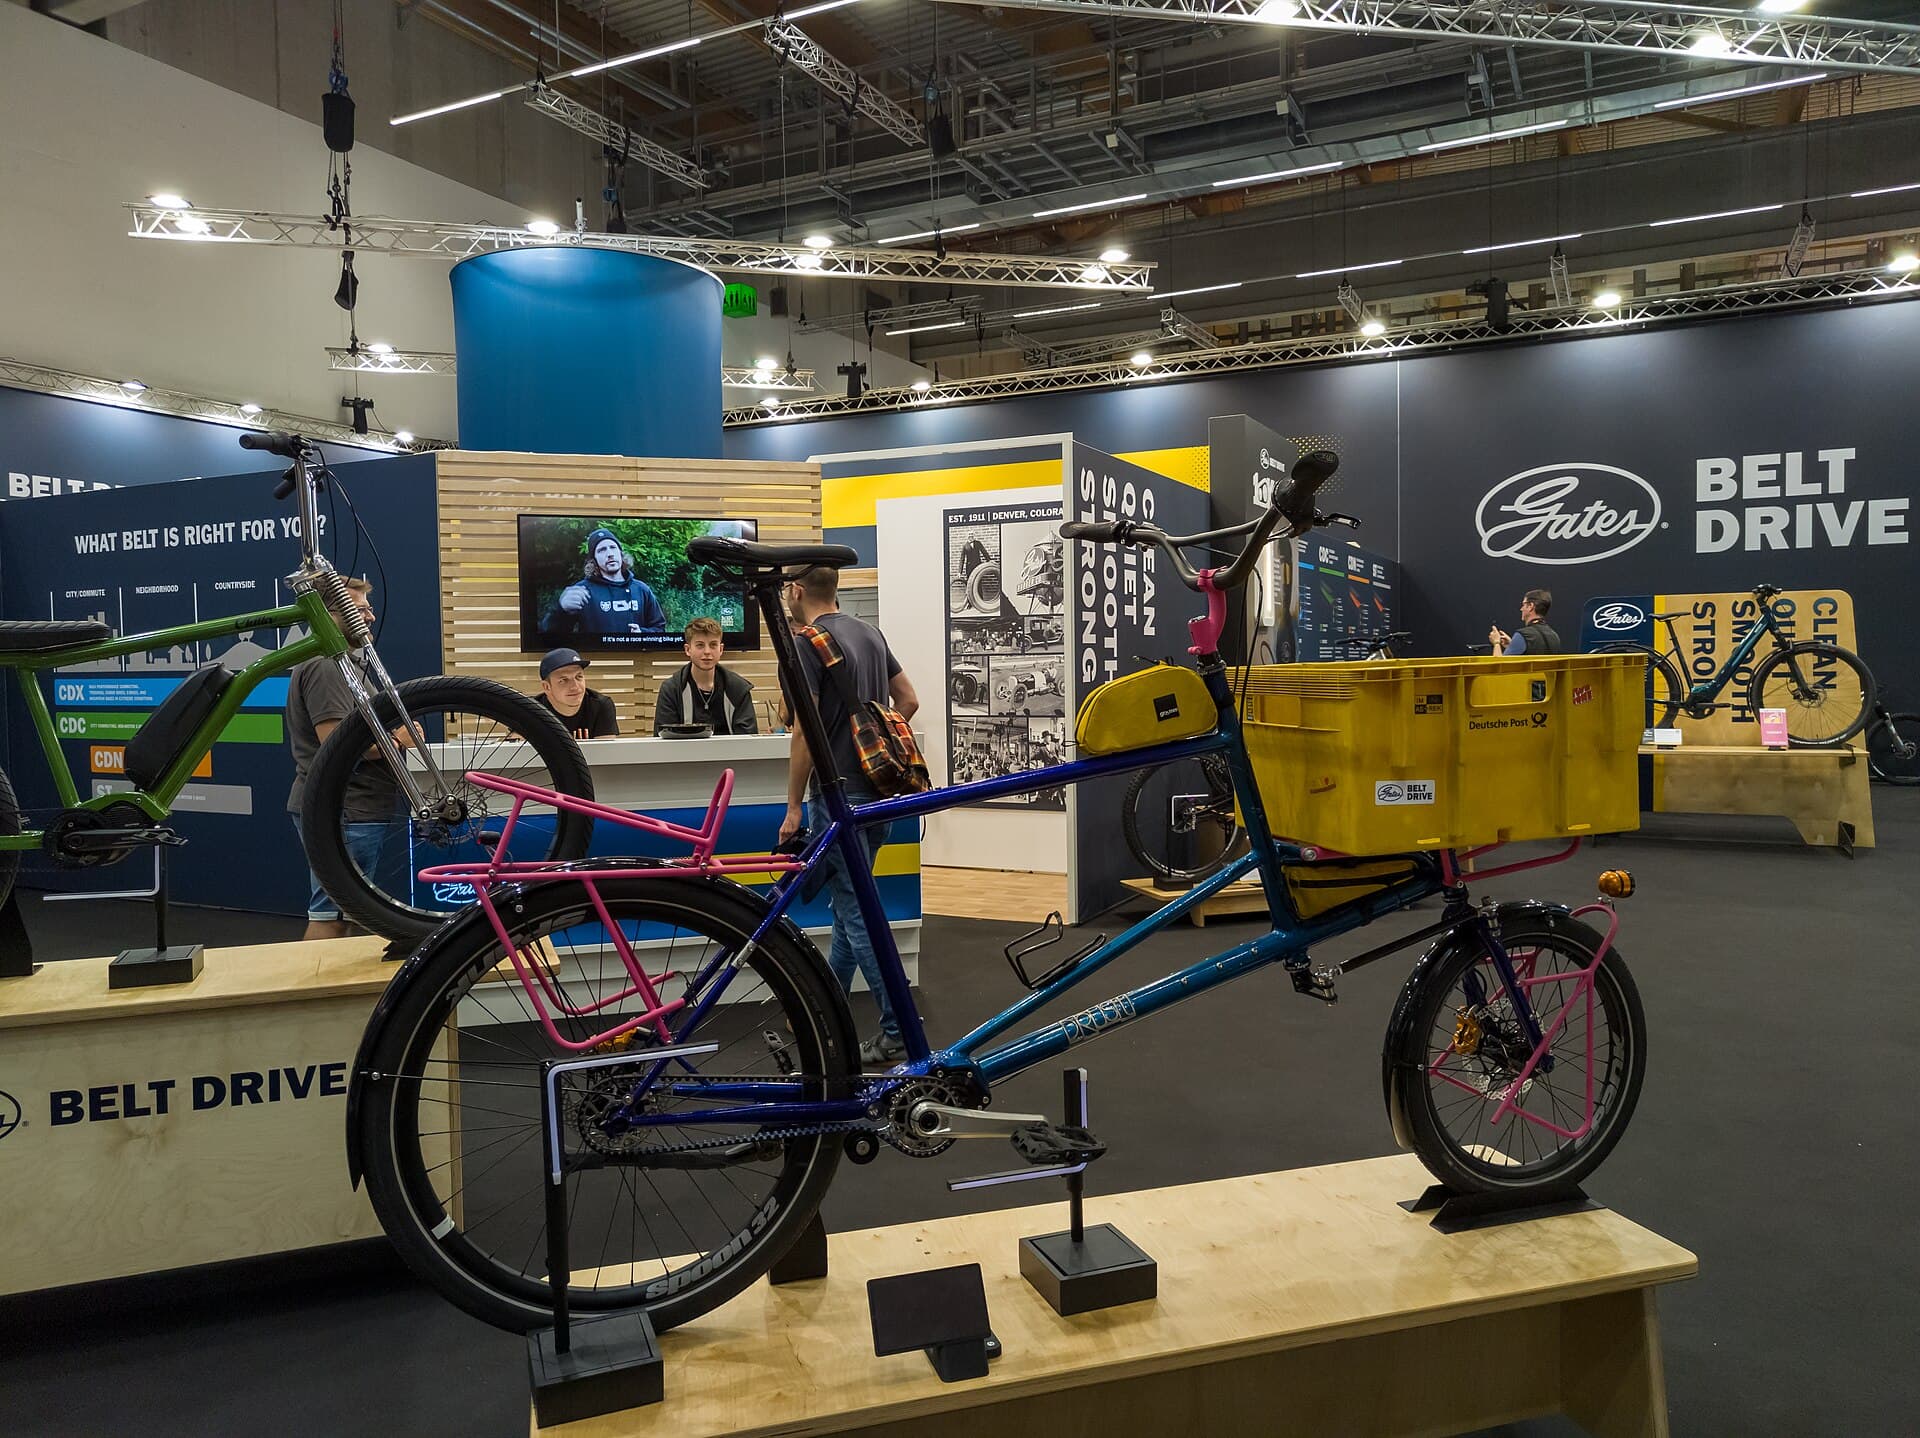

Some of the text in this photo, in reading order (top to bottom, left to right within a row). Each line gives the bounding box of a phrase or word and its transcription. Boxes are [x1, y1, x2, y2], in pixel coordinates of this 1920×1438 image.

[1696, 447, 1856, 503] BELT
[948, 507, 1064, 523] EST. 1911 DENVER, COLORA
[1480, 475, 1648, 560] Gates
[1695, 497, 1910, 554] DRIVE
[74, 514, 327, 554] WHAT BELT IS RIGHT FOR YO?
[1121, 482, 1137, 625] QIET
[1142, 488, 1155, 636] CEAN
[214, 580, 256, 591] COUNTRYSIDE
[1080, 466, 1097, 683] STRONG
[135, 584, 179, 594] NEIGHBORHOOD
[1594, 605, 1642, 629] Gates
[58, 684, 85, 701] CDX
[59, 717, 86, 734] CDC
[1469, 718, 1528, 730] Deutsche Post
[94, 751, 124, 768] CDN
[1407, 784, 1427, 792] BELT
[1407, 792, 1433, 801] DRIVE
[49, 1079, 176, 1126] BELT
[191, 1062, 348, 1111] DRIVE
[751, 1196, 780, 1235] 32
